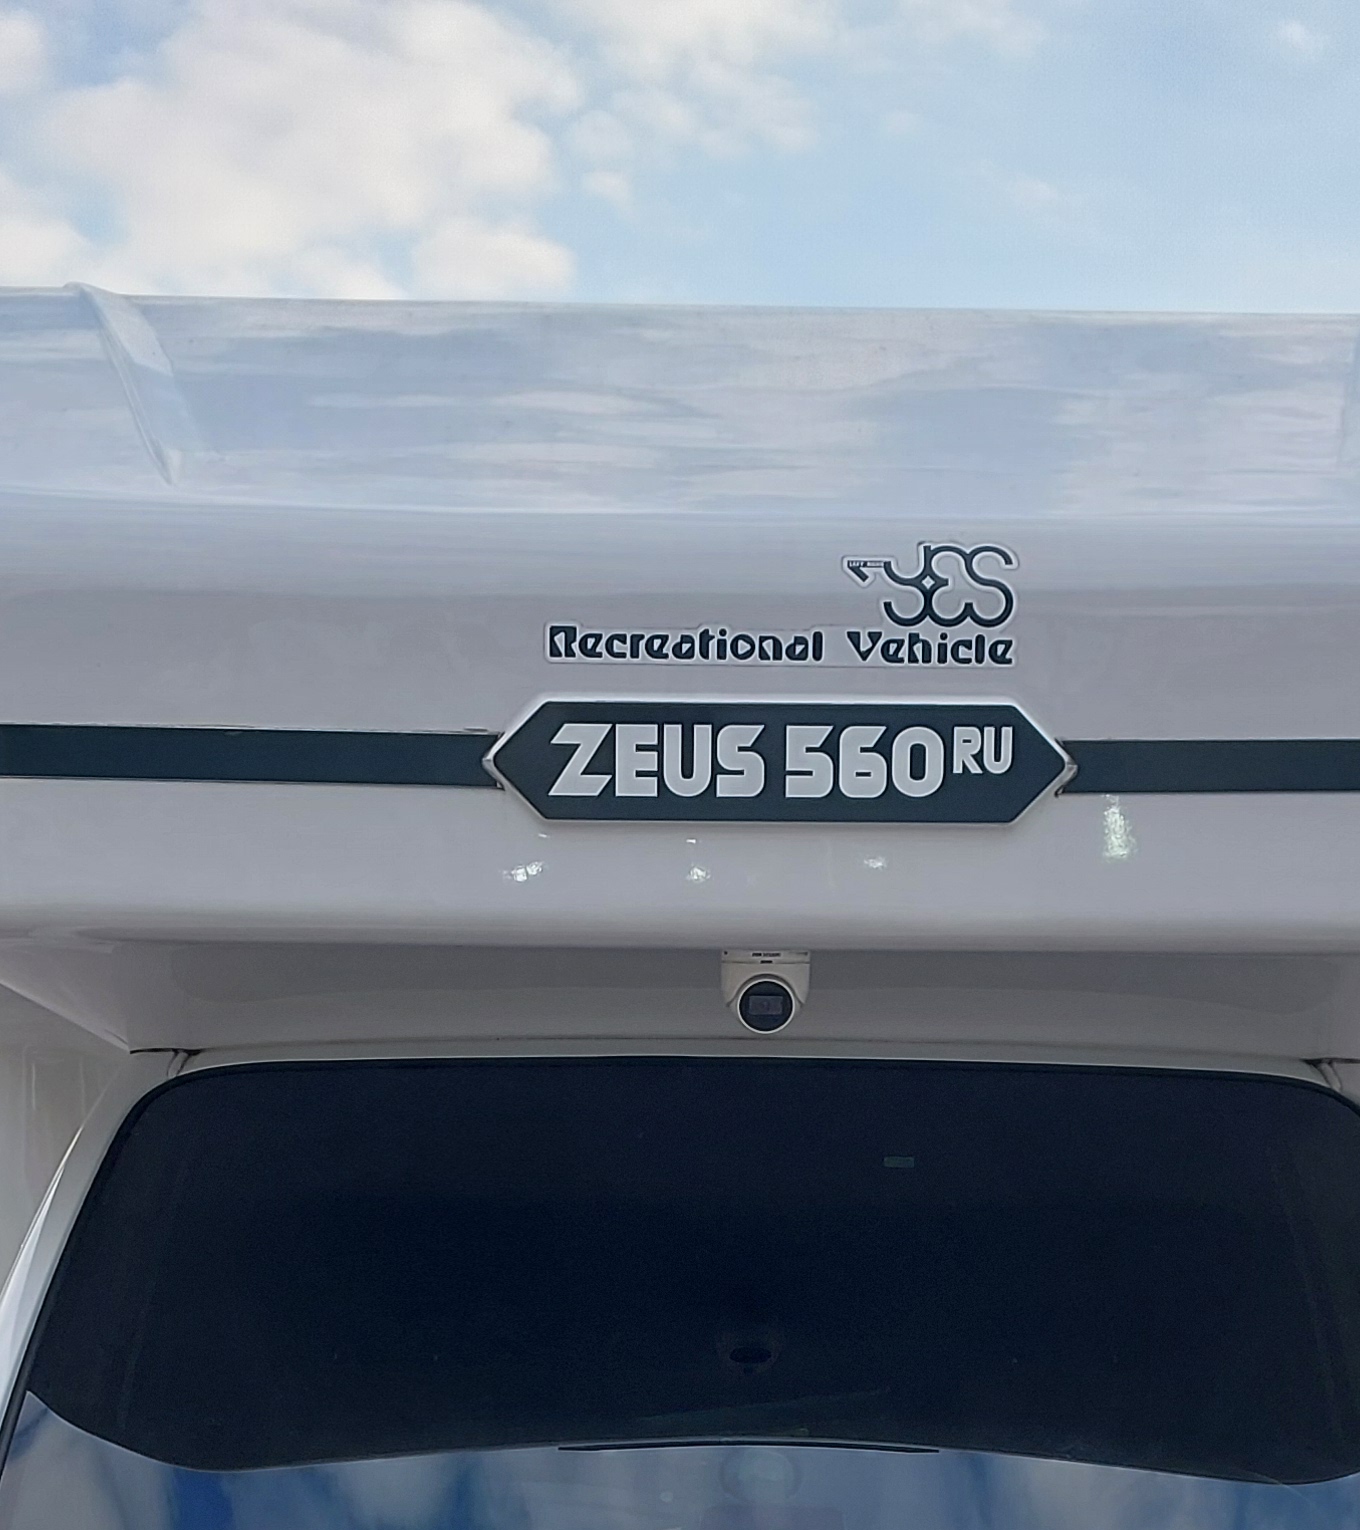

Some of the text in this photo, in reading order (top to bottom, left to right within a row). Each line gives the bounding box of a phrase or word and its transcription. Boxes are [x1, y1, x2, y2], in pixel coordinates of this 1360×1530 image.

[548, 624, 1014, 665] Recreational Vehicle
[547, 723, 1014, 799] ZEUS 560 RU
